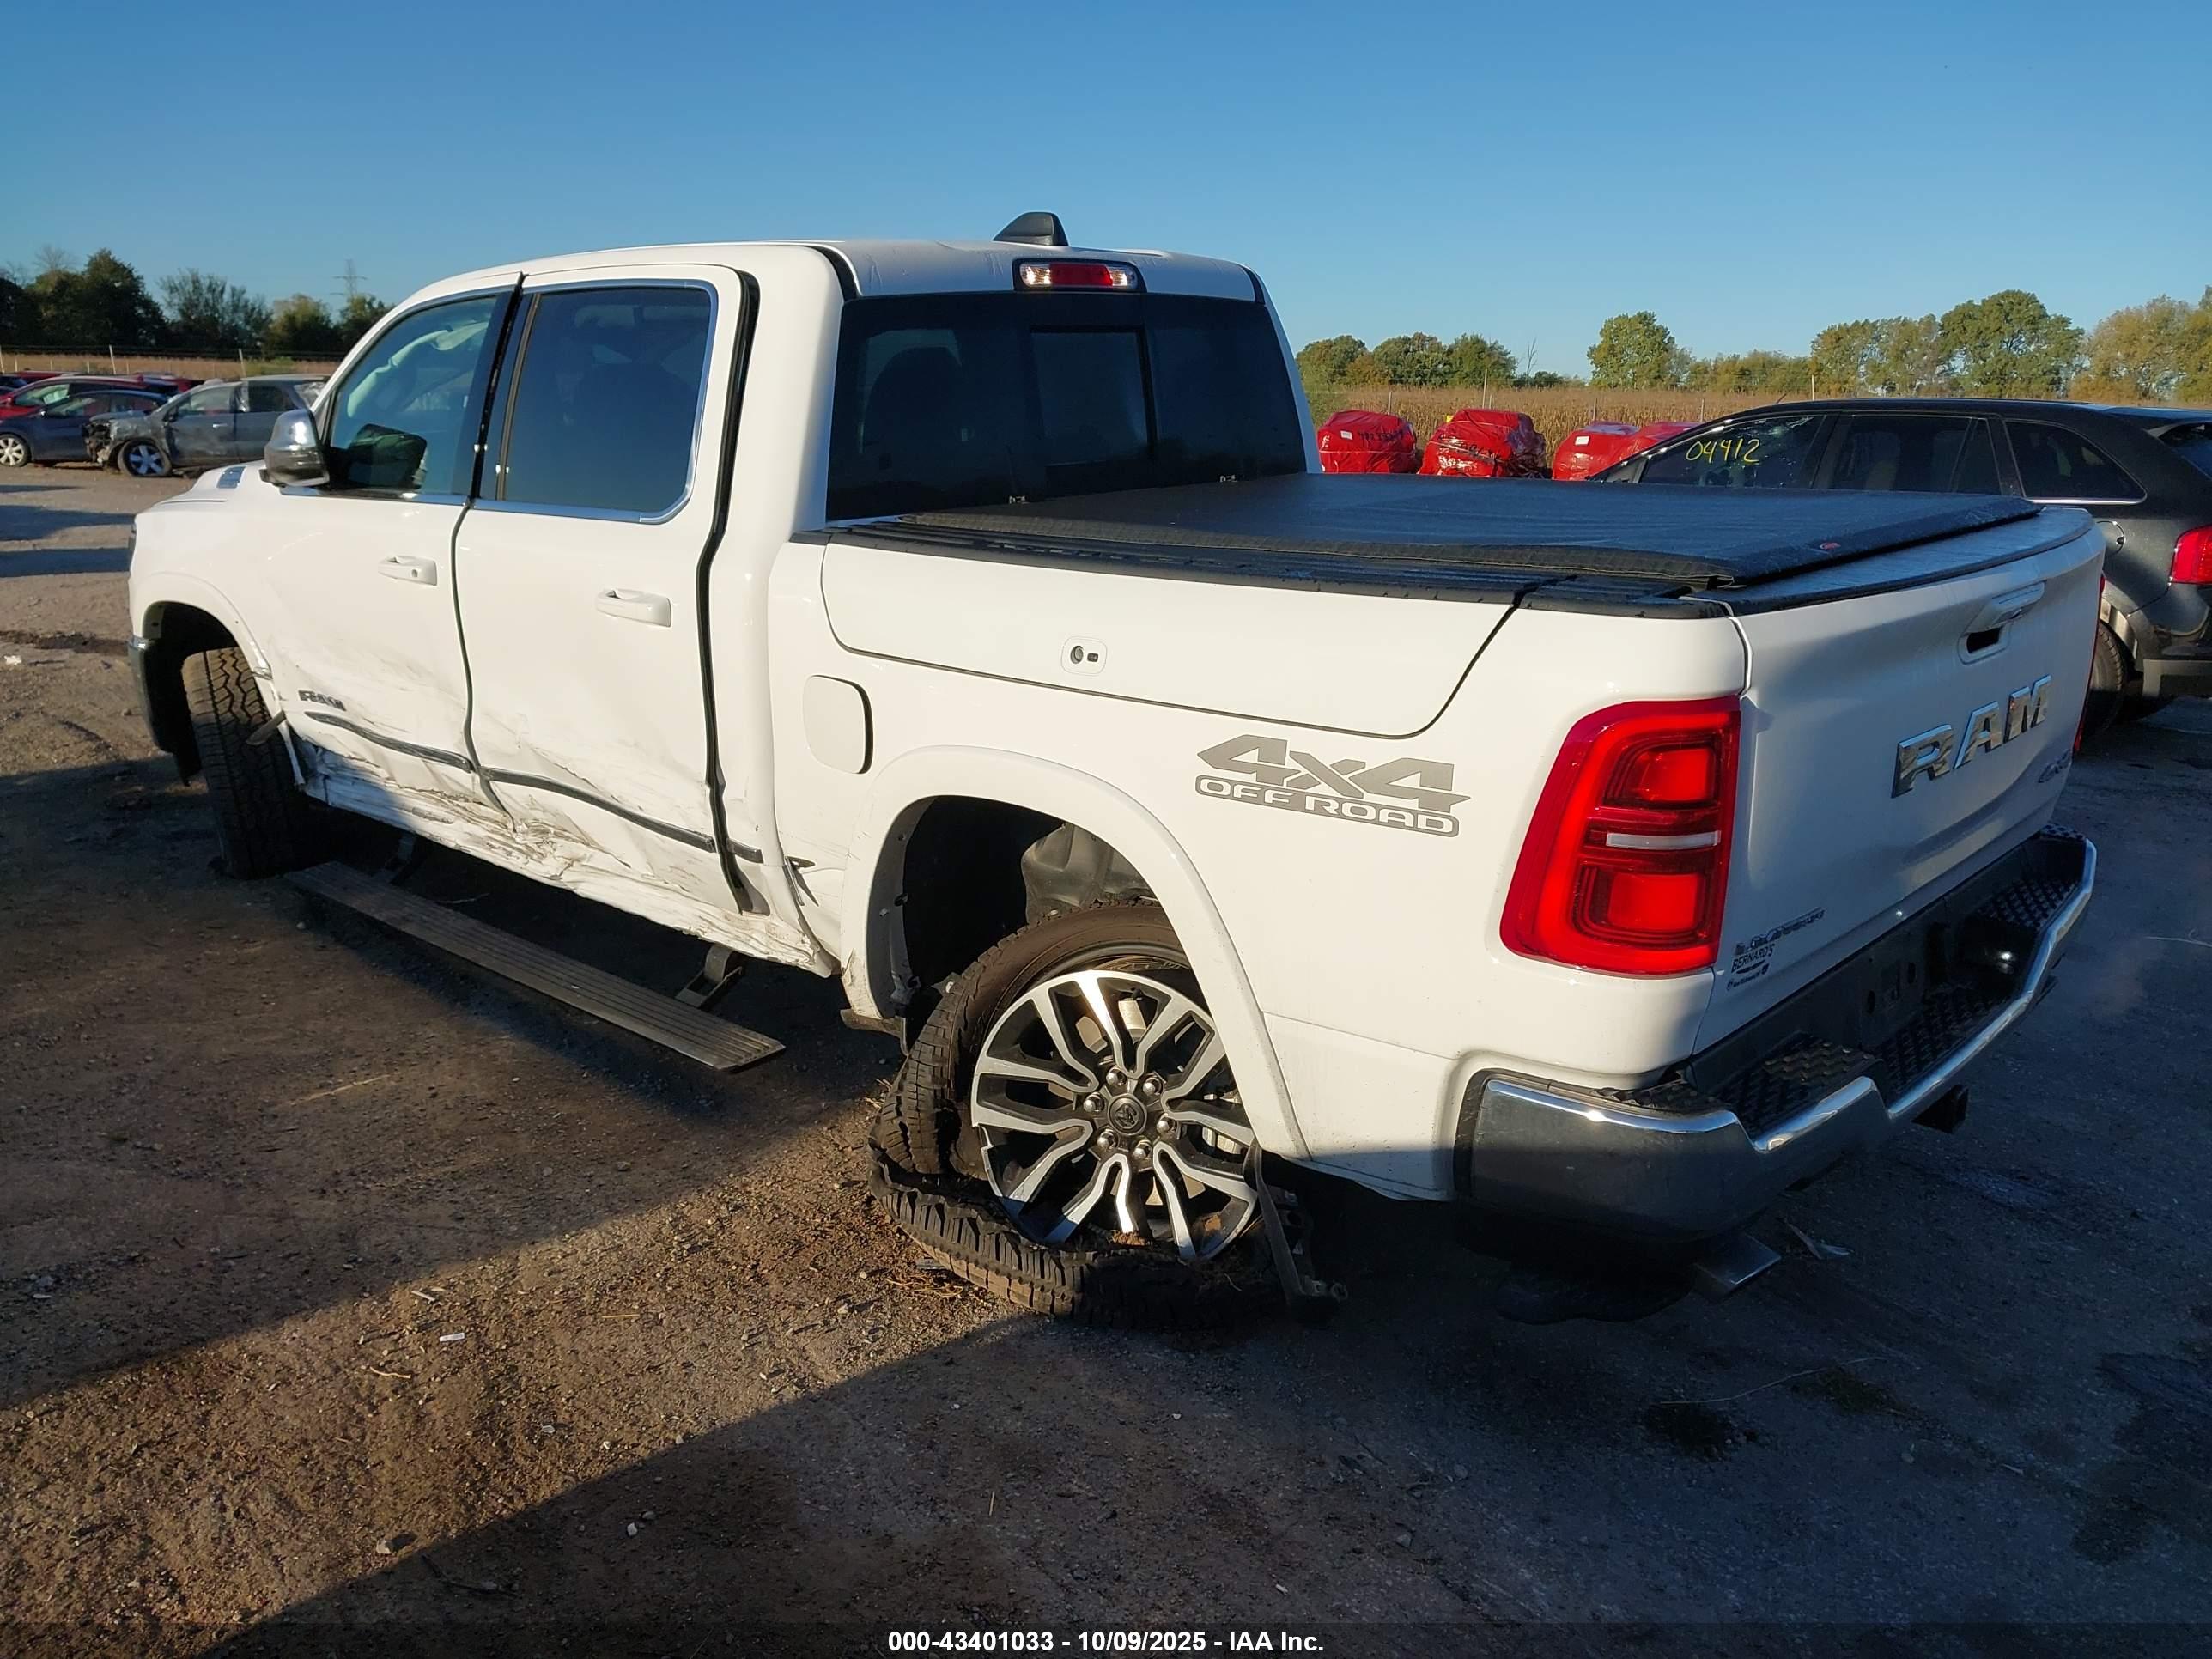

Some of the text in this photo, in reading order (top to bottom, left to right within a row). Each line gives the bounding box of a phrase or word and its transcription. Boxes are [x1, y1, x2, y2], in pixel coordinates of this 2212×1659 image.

[1686, 438, 1759, 465] 04412
[298, 690, 347, 712] RAM
[1891, 674, 2051, 799] RAM
[1200, 777, 1454, 834] OFF ROAD
